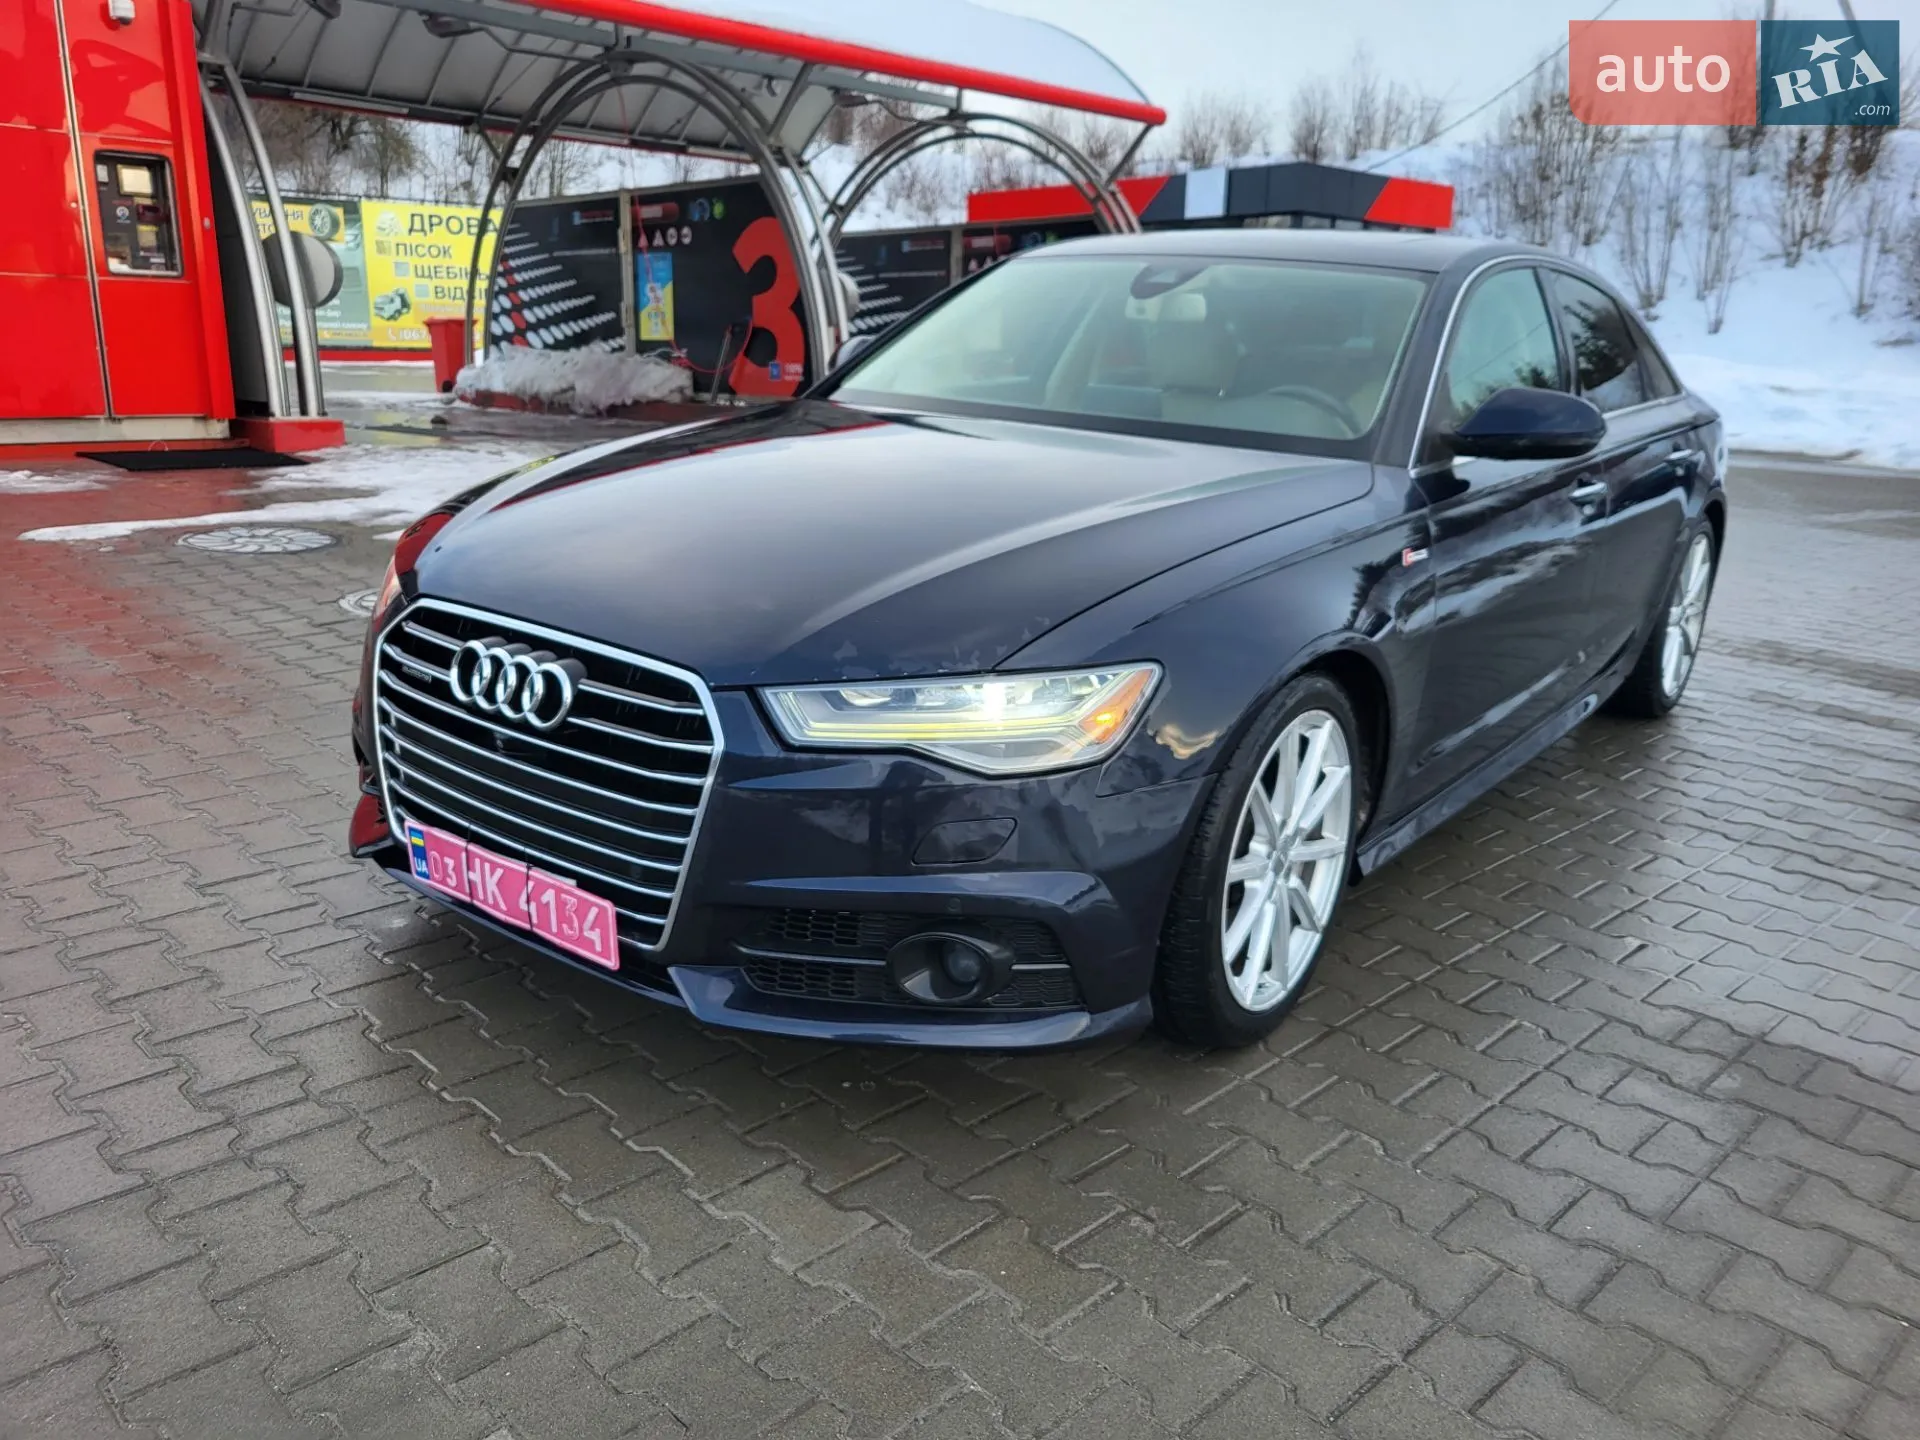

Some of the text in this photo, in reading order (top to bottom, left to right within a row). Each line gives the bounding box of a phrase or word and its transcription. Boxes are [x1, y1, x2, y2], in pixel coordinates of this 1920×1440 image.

[395, 242, 453, 259] ПІСОК
[728, 216, 805, 397] 3
[415, 857, 429, 875] UA
[519, 880, 602, 953] 4134
